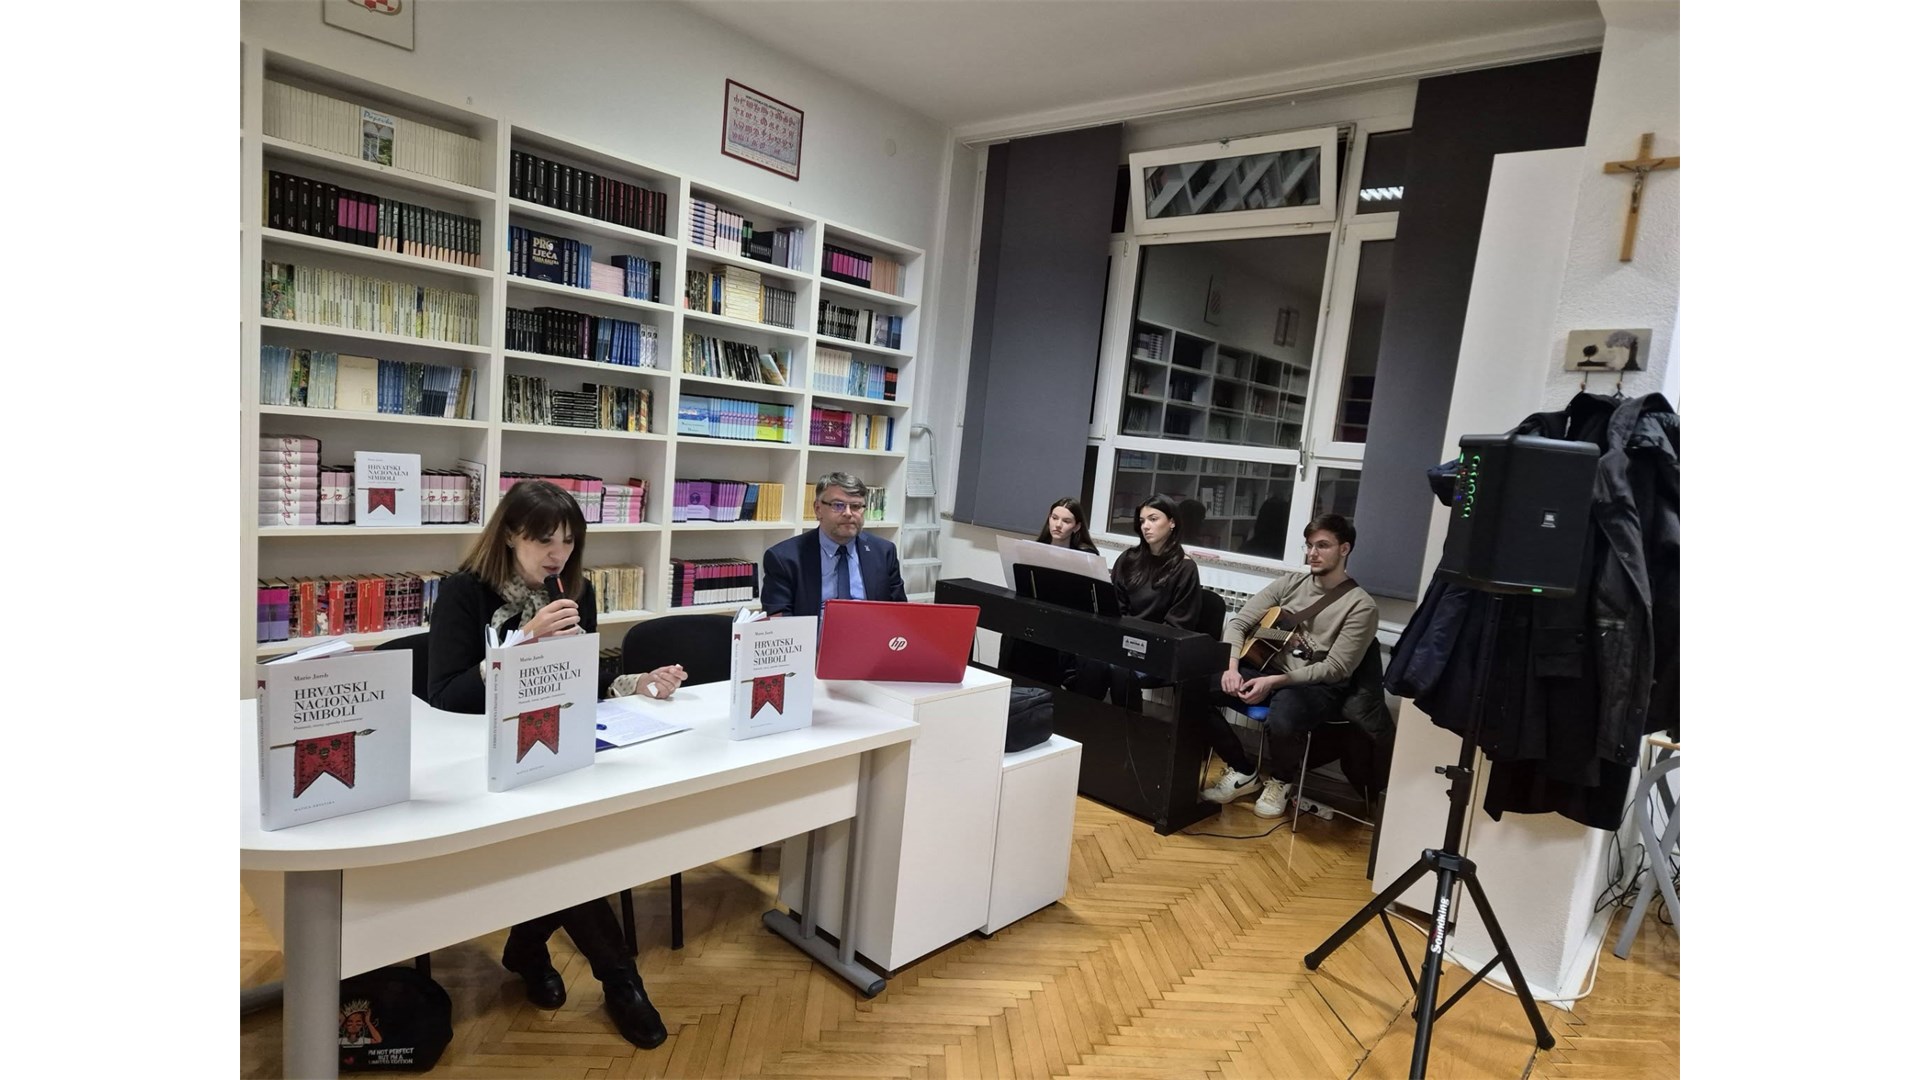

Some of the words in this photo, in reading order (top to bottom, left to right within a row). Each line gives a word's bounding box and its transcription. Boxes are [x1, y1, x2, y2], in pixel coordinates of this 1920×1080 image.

[533, 236, 554, 251] PRO
[754, 637, 794, 649] HRVATSKI
[754, 644, 802, 657] NACIONALNI
[890, 637, 906, 650] hp
[753, 654, 787, 666] SIMBOLI
[519, 661, 570, 679] HRVATSKI
[519, 668, 581, 689] NACIONALNI
[294, 680, 369, 700] HRVATSKI
[518, 681, 561, 699] SIMBOLI
[293, 689, 385, 712] NACIONALNI
[293, 705, 356, 724] SIMBOLI
[1430, 895, 1450, 954] Soundking
